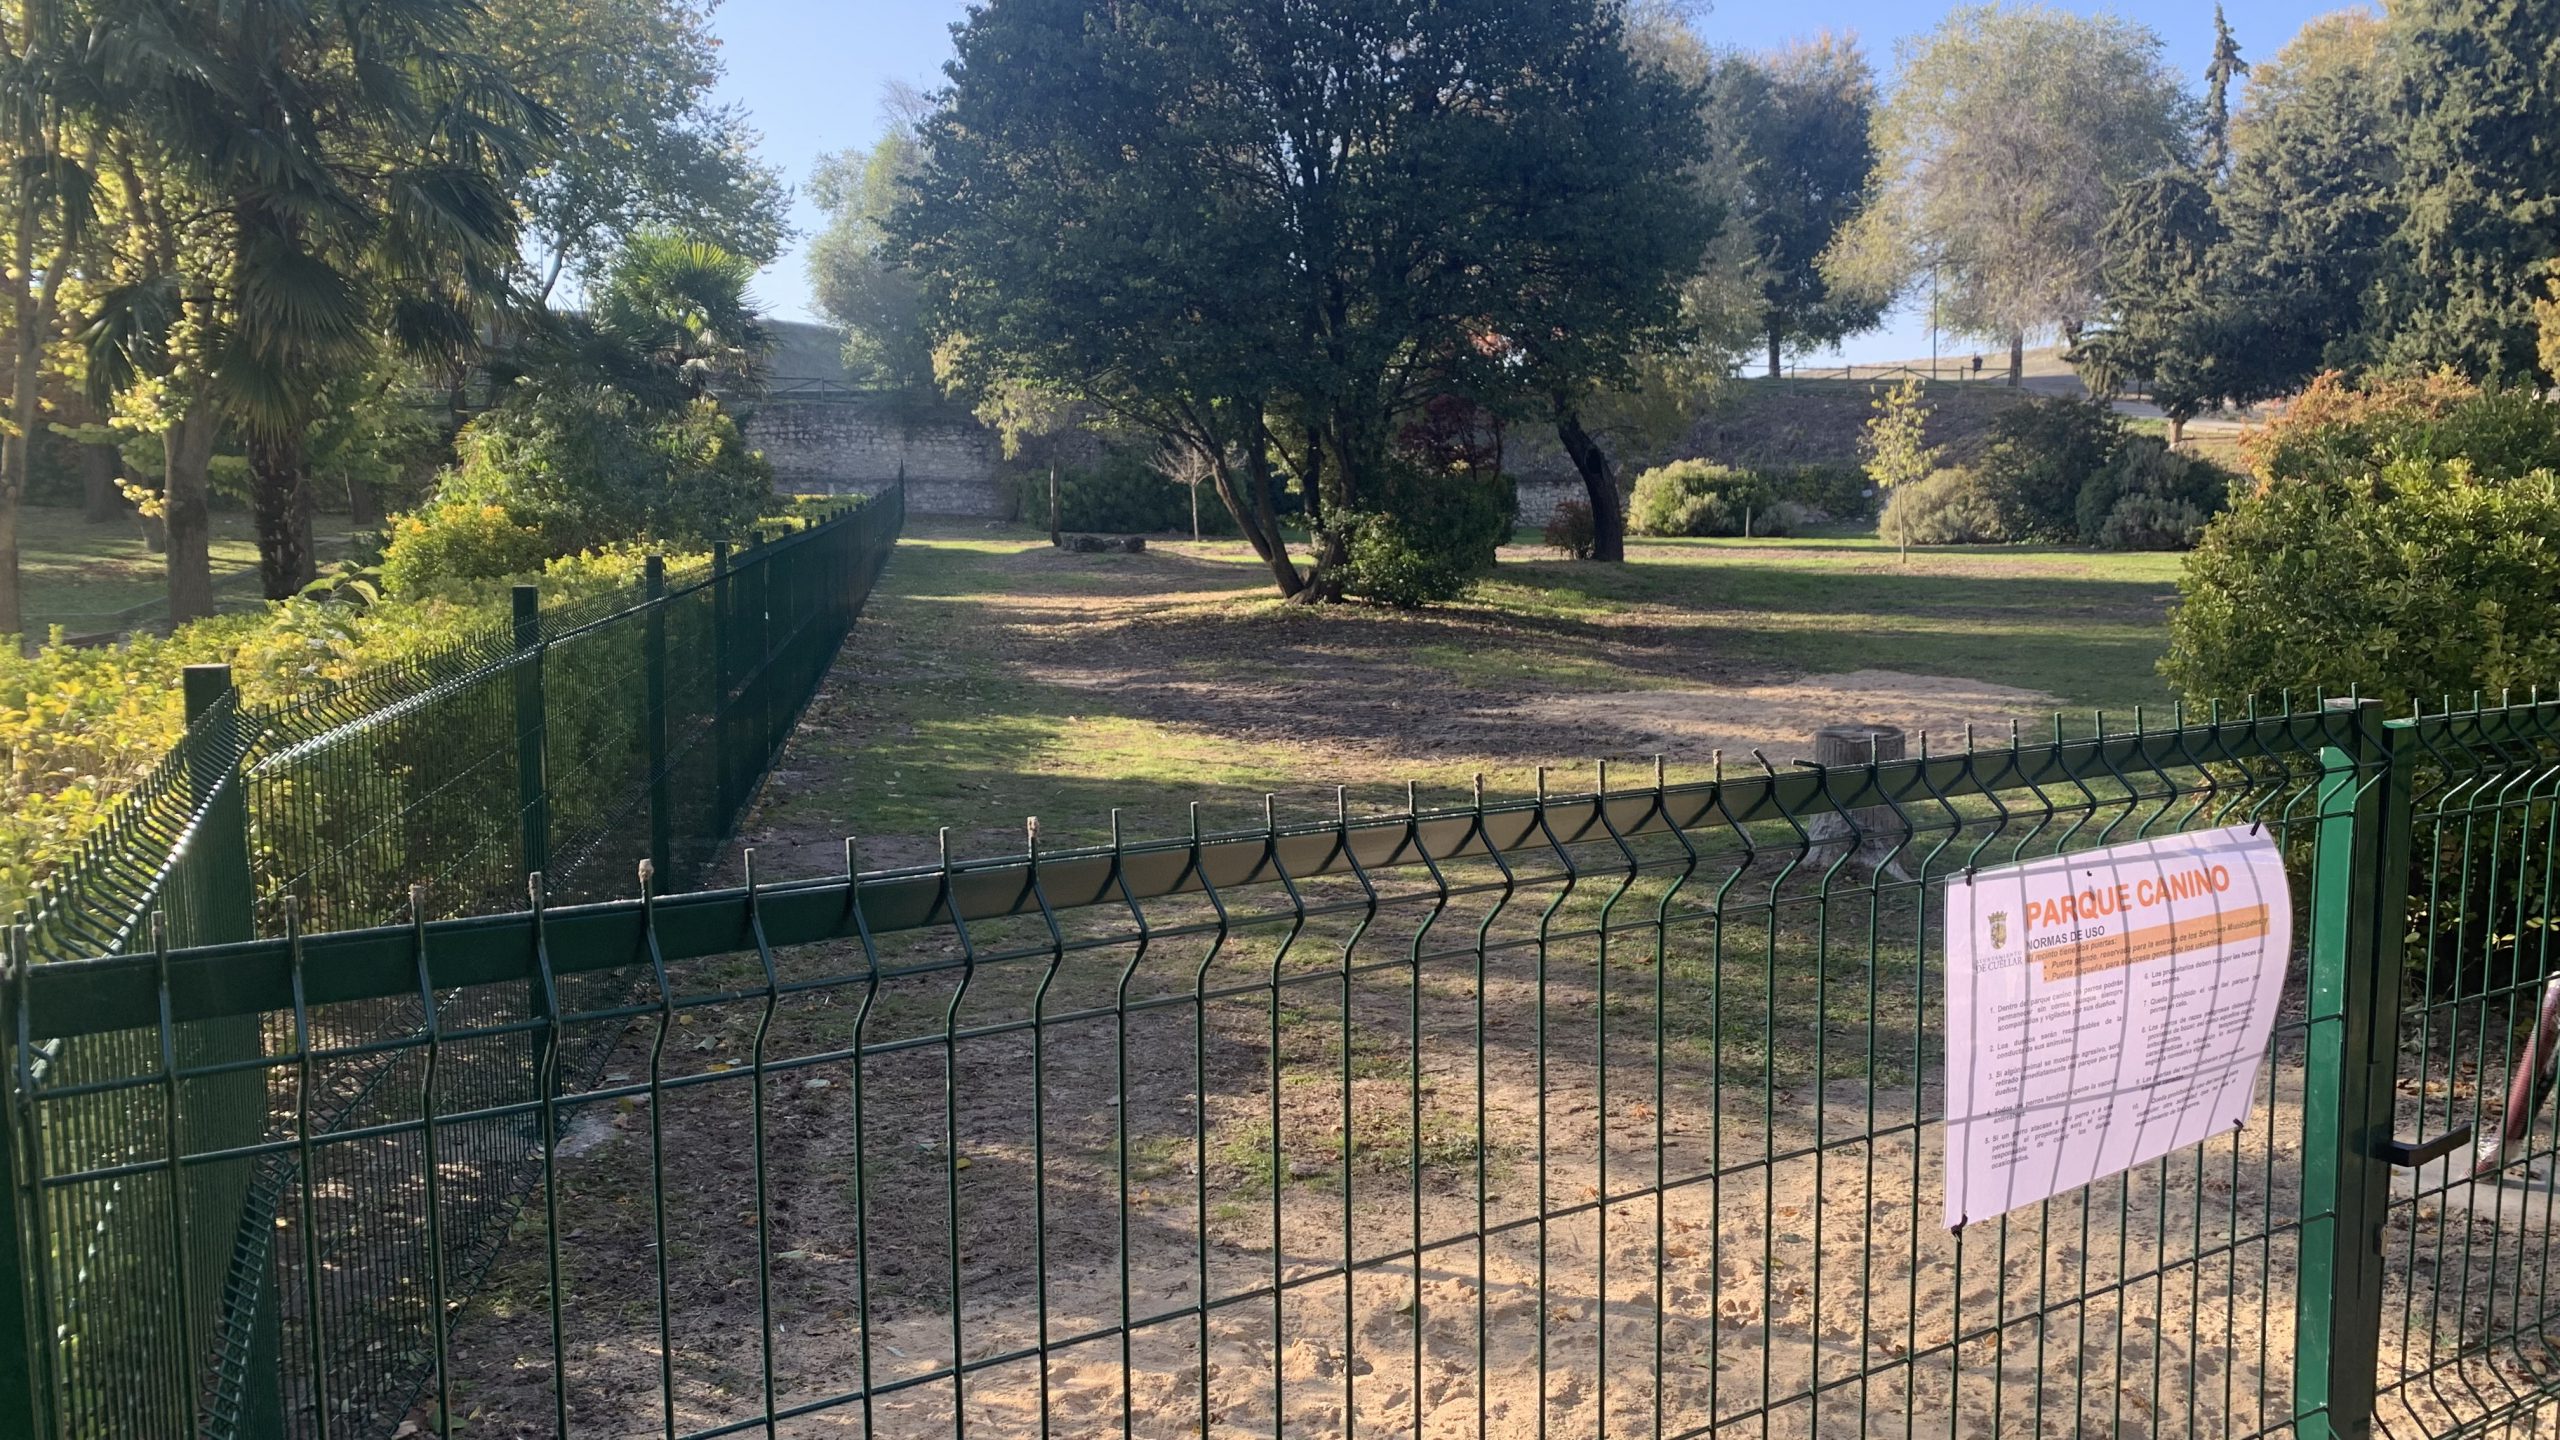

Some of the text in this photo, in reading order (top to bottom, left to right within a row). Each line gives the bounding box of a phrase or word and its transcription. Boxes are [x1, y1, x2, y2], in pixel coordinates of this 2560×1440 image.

[2026, 864, 2230, 931] PARQUE CANINO
[2027, 925, 2105, 950] NORMAS DE USO
[2035, 951, 2058, 961] recinto
[2059, 947, 2075, 958] tiene
[2091, 938, 2117, 953] puertas:
[2051, 958, 2073, 969] Puerta
[2132, 942, 2148, 954] para
[2188, 931, 2197, 940] los
[1975, 963, 1987, 974] DE
[2051, 970, 2073, 980] Puerta
[2105, 960, 2120, 972] para
[2185, 943, 2194, 952] los
[1997, 1003, 2018, 1012] Dentro
[2030, 996, 2051, 1007] parque
[2052, 990, 2072, 1000] canino
[2084, 984, 2102, 995] perros
[2037, 1005, 2046, 1013] sin
[2045, 1010, 2072, 1022] vigilados
